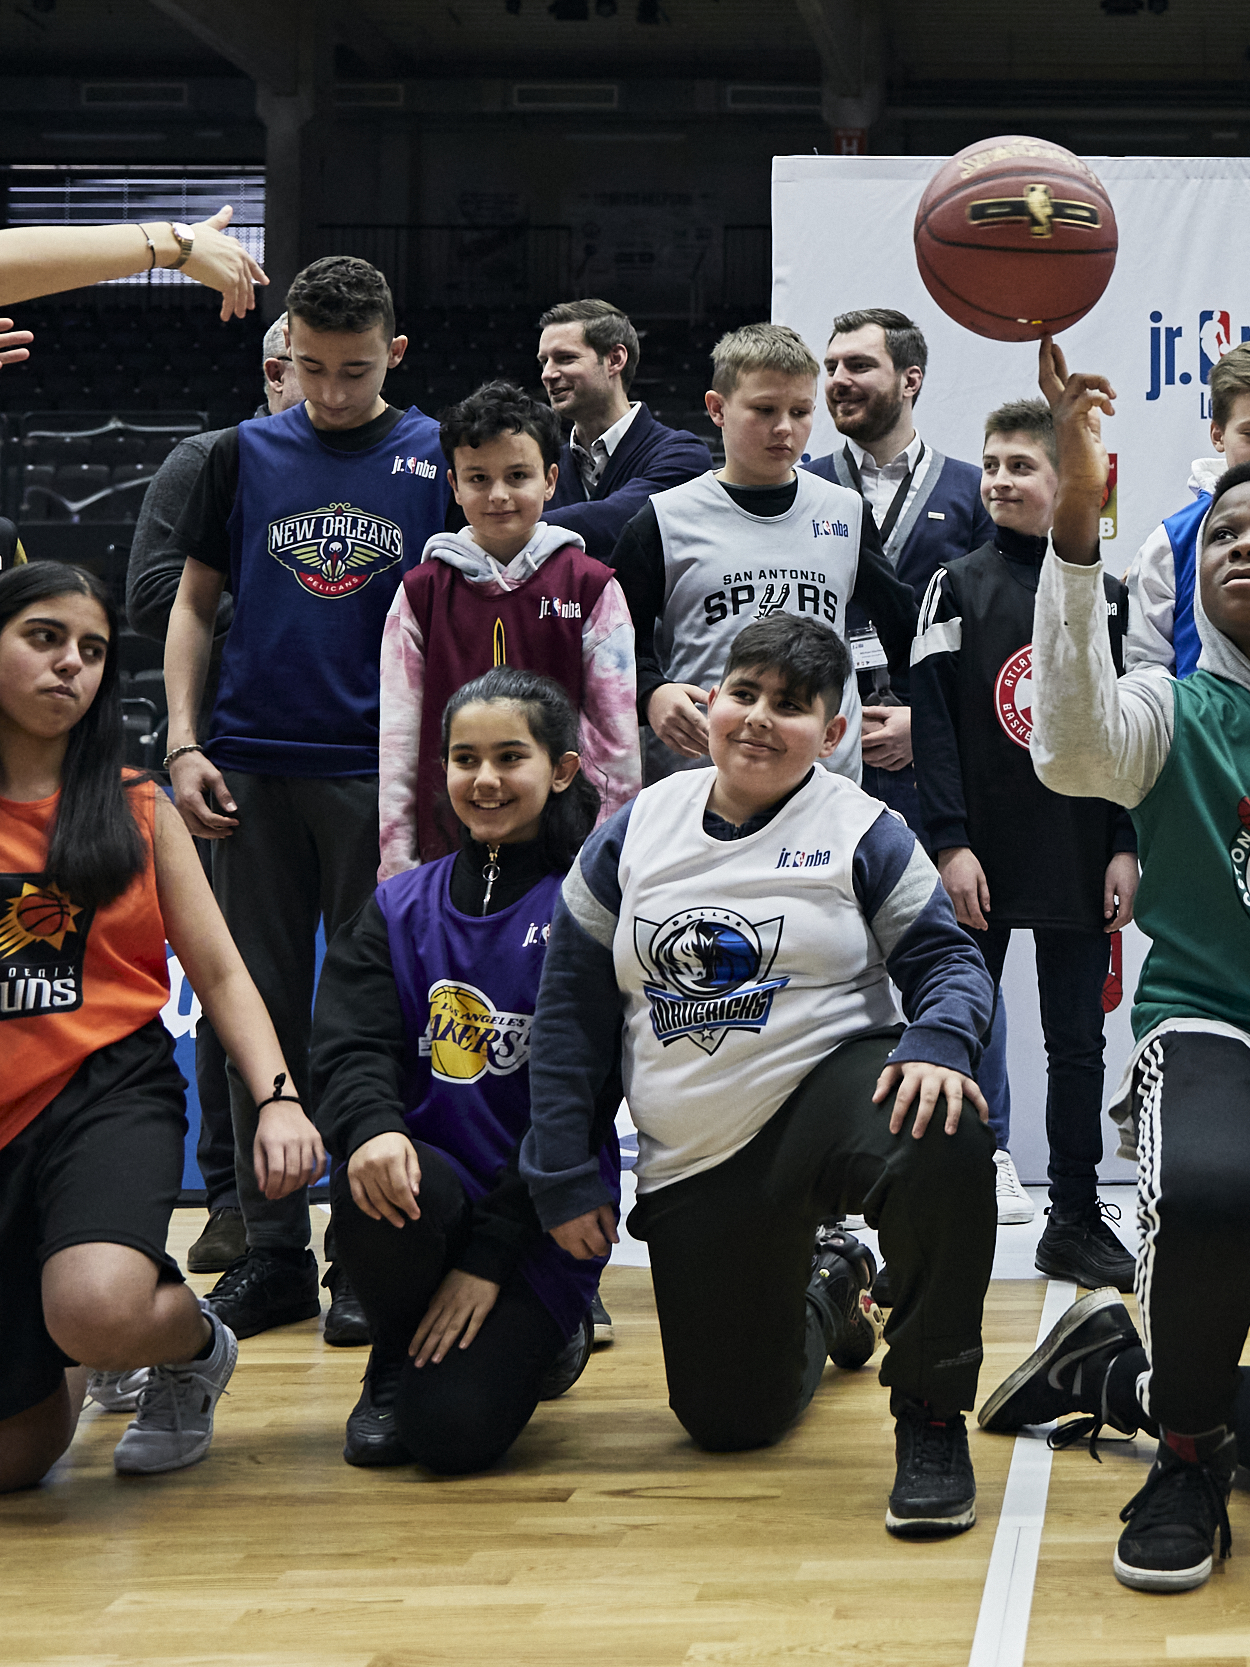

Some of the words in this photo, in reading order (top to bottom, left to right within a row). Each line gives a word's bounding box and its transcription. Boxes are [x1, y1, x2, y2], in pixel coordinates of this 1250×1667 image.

[271, 516, 316, 550] NEW
[322, 516, 402, 556] ORLEANS
[306, 575, 359, 593] PELICANS
[723, 571, 753, 586] SAN
[758, 569, 827, 584] ANTONIO
[704, 582, 838, 627] SPURS
[672, 911, 742, 927] DALLAS
[460, 1012, 526, 1028] ANGELES
[652, 992, 771, 1036] MAVERICKS
[428, 1013, 526, 1069] AKERS
